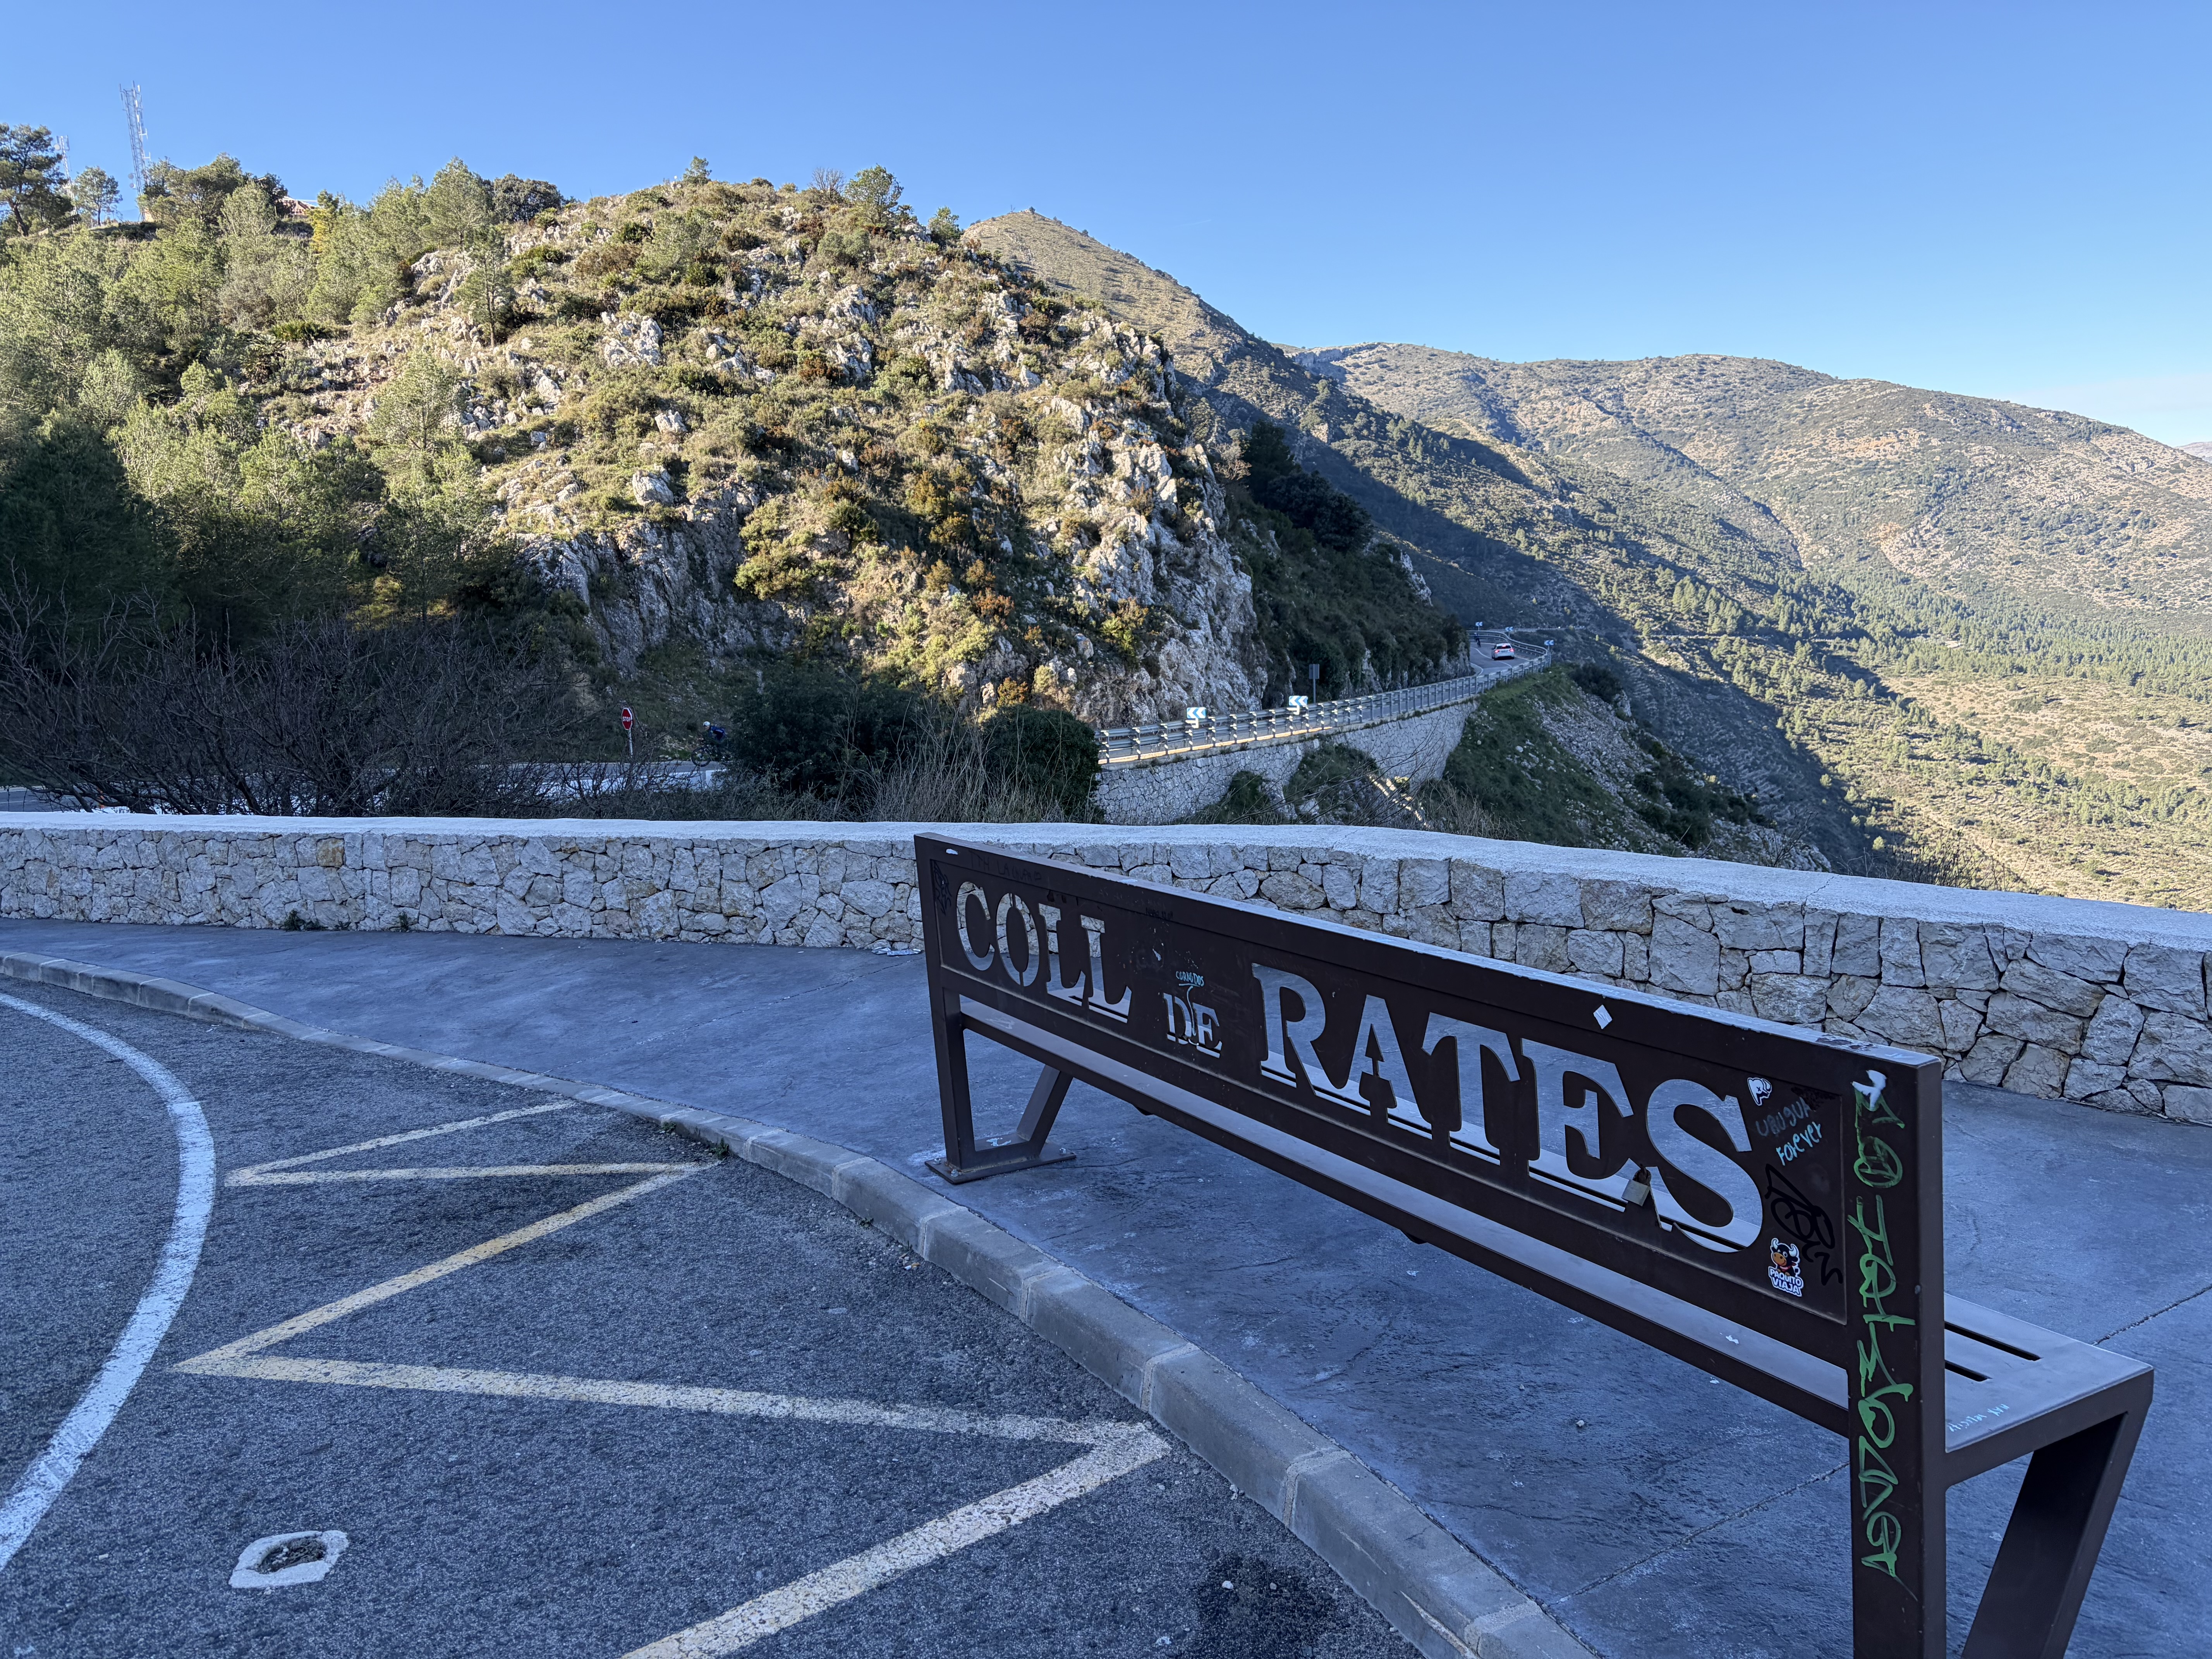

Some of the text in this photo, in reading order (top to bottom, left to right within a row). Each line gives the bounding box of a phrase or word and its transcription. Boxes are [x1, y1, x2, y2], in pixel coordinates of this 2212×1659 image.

[956, 881, 1132, 1023] COLL
[1164, 994, 1223, 1058] DE
[1252, 963, 1763, 1252] RATES
[1770, 1267, 1802, 1287] PAQUITO
[1772, 1277, 1800, 1294] VIAJA
